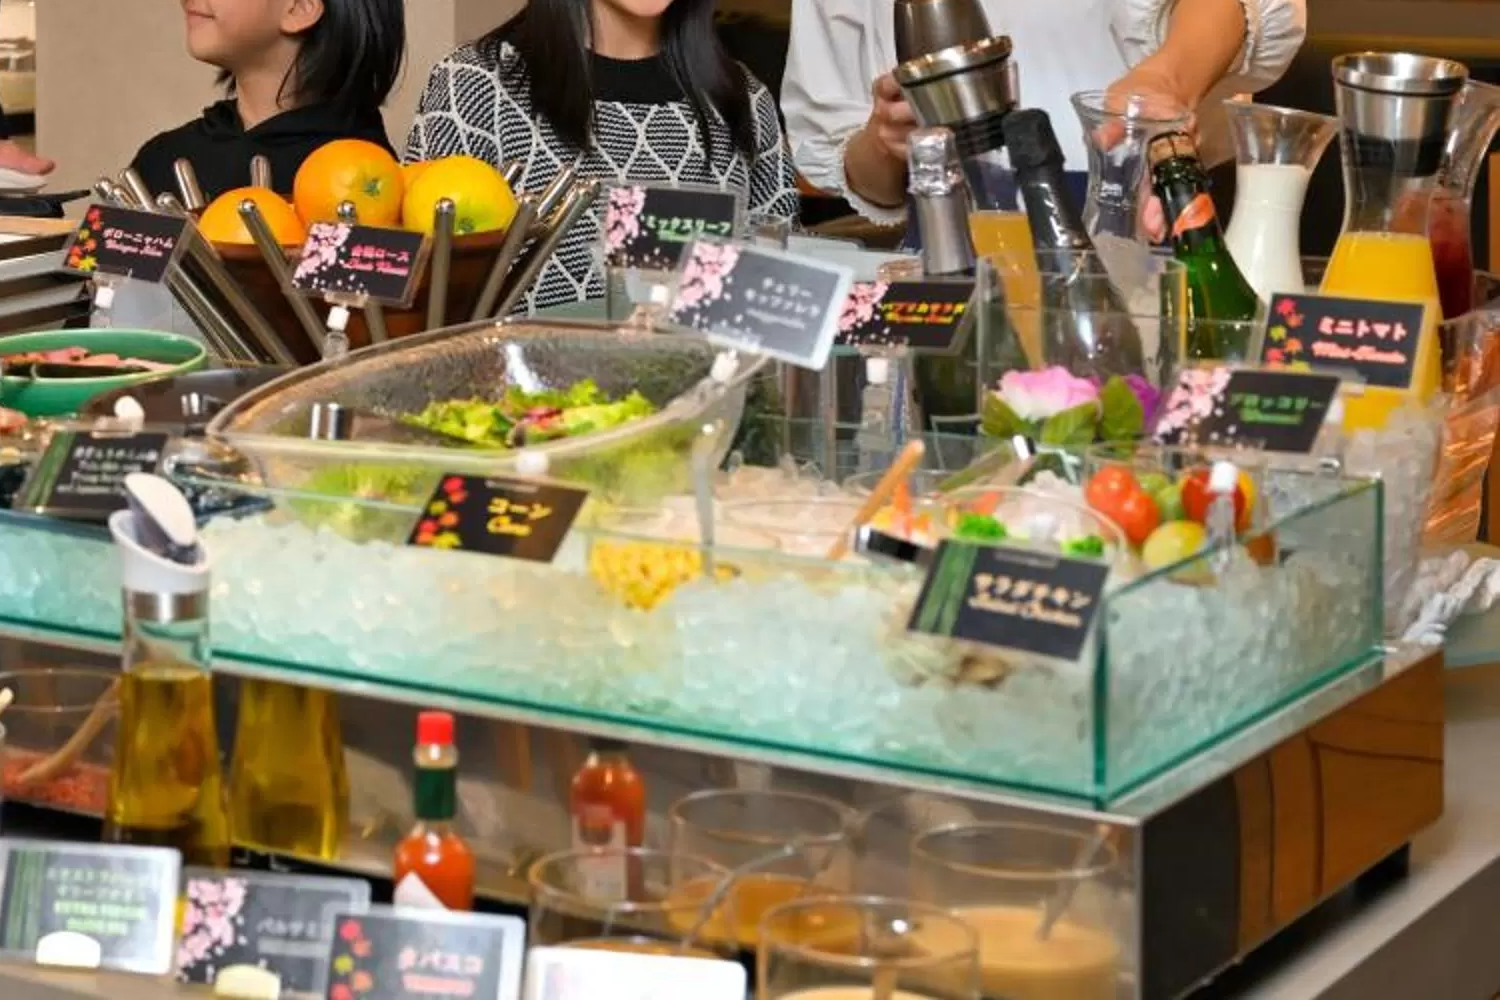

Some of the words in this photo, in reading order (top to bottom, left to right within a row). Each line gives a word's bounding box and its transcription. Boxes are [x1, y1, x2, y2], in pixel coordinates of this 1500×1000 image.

[1318, 315, 1408, 342] ミニトマト
